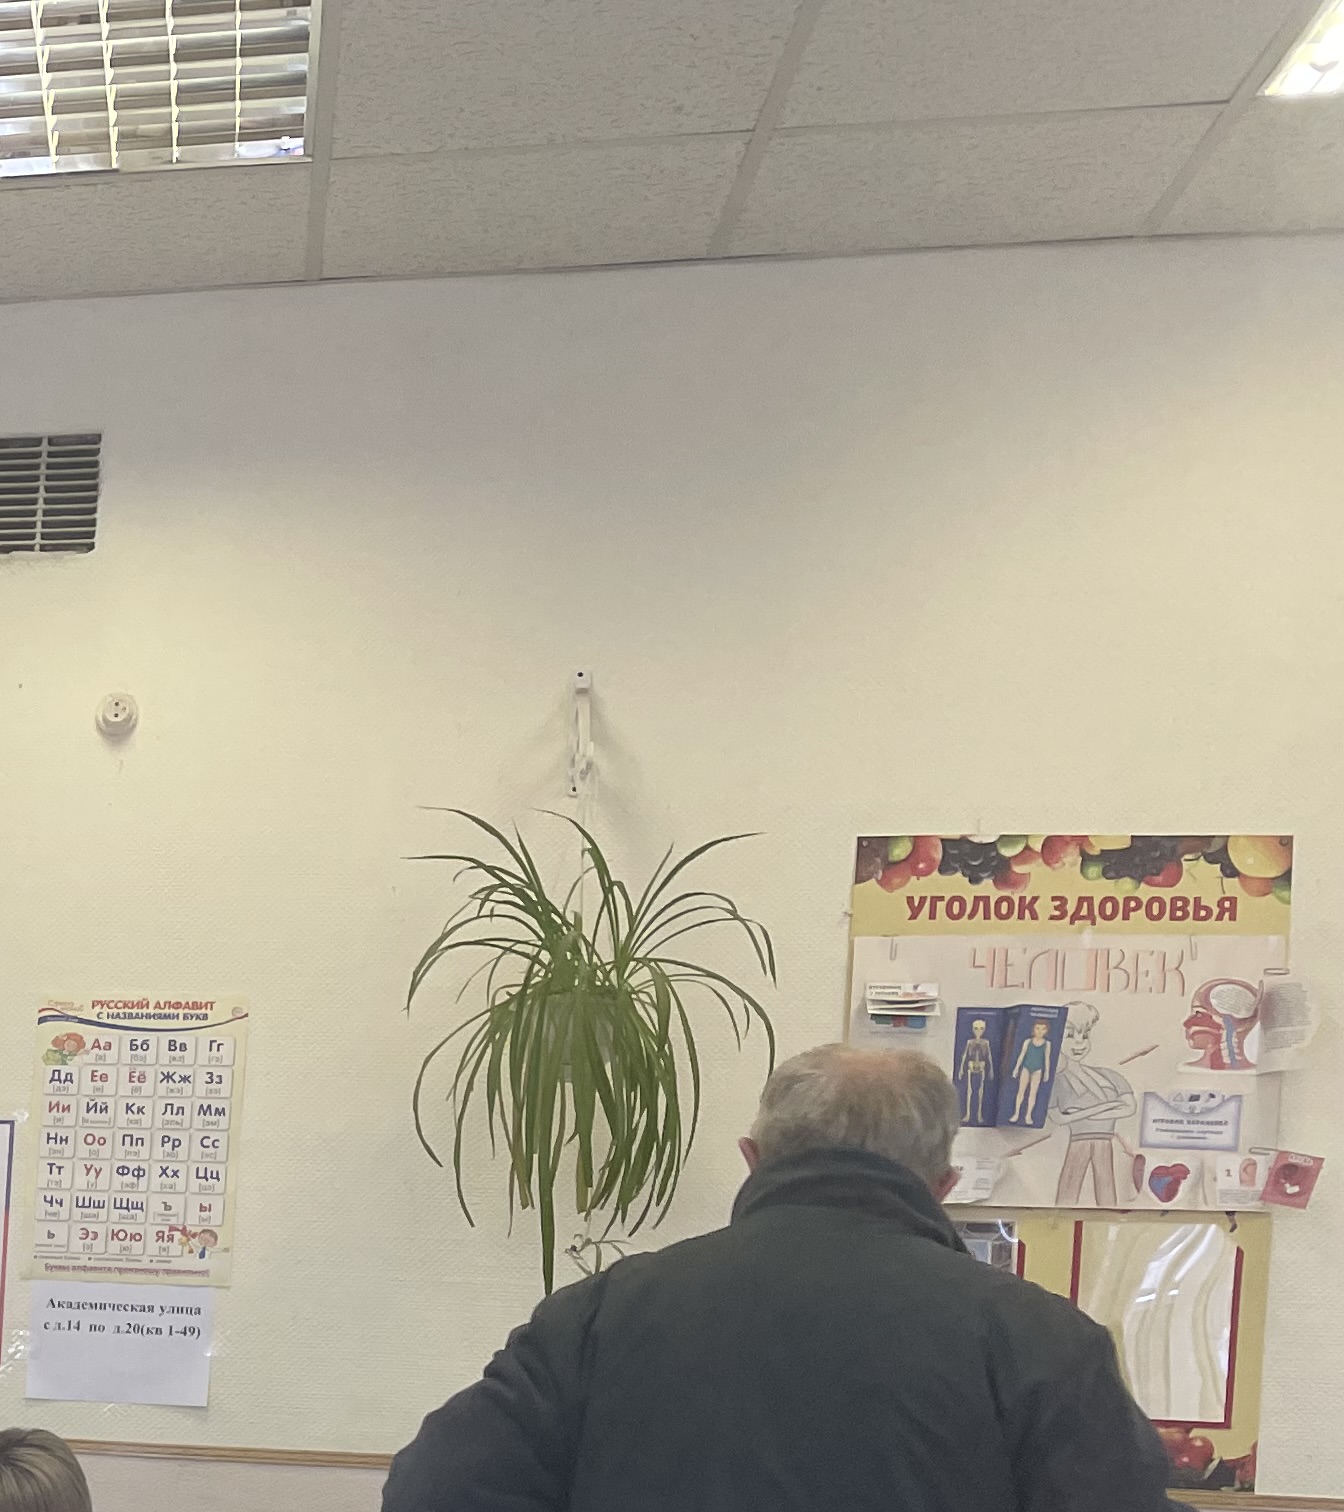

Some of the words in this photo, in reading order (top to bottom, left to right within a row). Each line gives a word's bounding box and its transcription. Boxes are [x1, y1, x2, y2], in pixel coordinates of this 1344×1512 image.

[906, 895, 1039, 923] УГОЛОК
[1049, 896, 1238, 926] ЗДОРОВЬЯ
[970, 945, 1188, 996] ЧЕЛОВЕК
[91, 998, 149, 1010] РУССКИЙ
[153, 1001, 216, 1010] АЛФАВИТ
[183, 1013, 209, 1021] БУКВ
[91, 1039, 112, 1051] Аа
[129, 1039, 149, 1051] Бб
[168, 1040, 188, 1052] Вв
[209, 1040, 224, 1052] Гг
[49, 1070, 74, 1084] Дд
[91, 1070, 108, 1082] Ее
[129, 1067, 146, 1084] Ёё
[160, 1071, 192, 1084] Жж
[205, 1072, 222, 1084] Зз
[48, 1100, 70, 1112] Ии
[86, 1098, 108, 1113] Йй
[125, 1102, 145, 1114] Кк
[162, 1103, 184, 1115] Лл
[198, 1104, 226, 1115] Мм
[47, 1132, 68, 1144] Нн
[84, 1133, 106, 1145] Оо
[122, 1133, 144, 1146] Пп
[162, 1135, 182, 1150] Рр
[200, 1135, 219, 1148] Сс
[47, 1162, 64, 1174] Тт
[84, 1163, 102, 1178] Уу
[116, 1164, 145, 1180] Фф
[159, 1165, 179, 1177] Хх
[196, 1166, 220, 1181] Цц
[44, 1194, 63, 1206] Чч
[76, 1195, 105, 1208] Шш
[113, 1196, 144, 1211] Щщ
[79, 1227, 98, 1239] Ээ
[111, 1228, 142, 1241] Юю
[156, 1230, 175, 1242] Яя
[46, 1298, 154, 1313] Академическая
[159, 1305, 201, 1316] улица
[44, 1321, 50, 1330] с
[53, 1320, 81, 1331] д.14
[89, 1323, 105, 1332] по
[113, 1322, 163, 1335] д.20(кв
[168, 1326, 201, 1339] 1-49)
